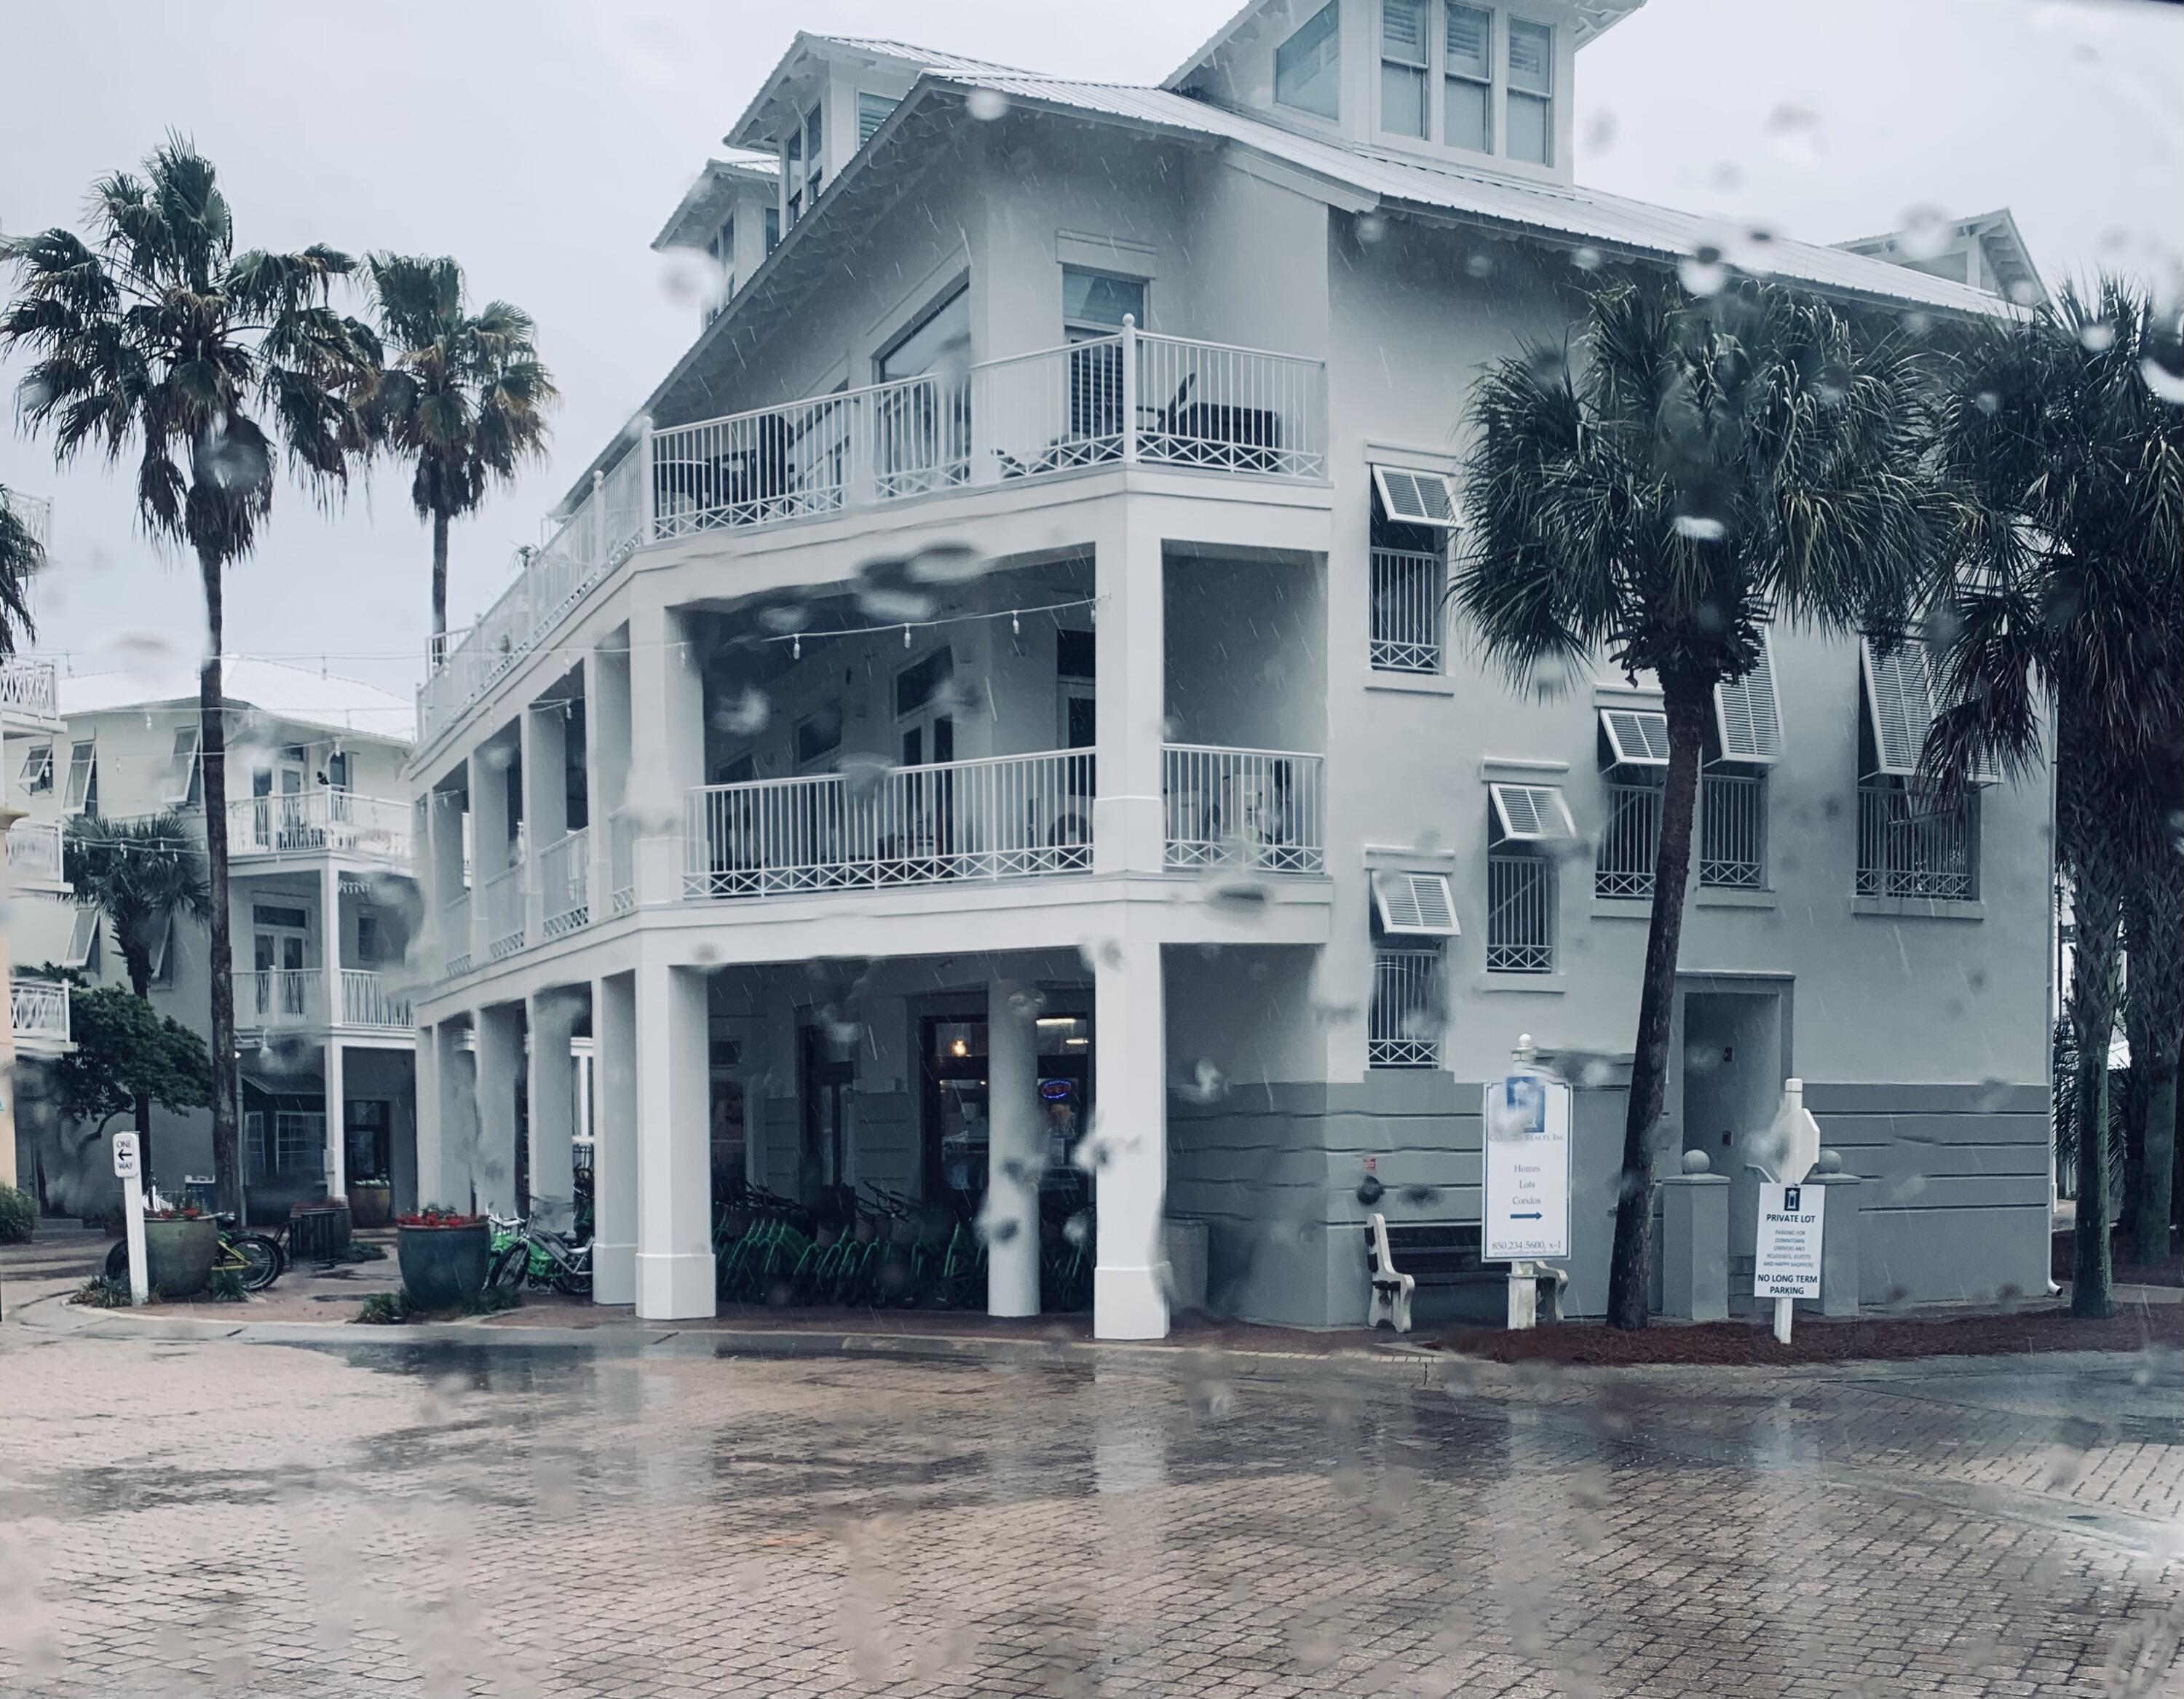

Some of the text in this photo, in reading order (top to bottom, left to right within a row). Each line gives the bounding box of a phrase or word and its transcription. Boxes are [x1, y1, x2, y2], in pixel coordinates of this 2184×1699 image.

[1041, 1085, 1071, 1095] OPEN
[1514, 1164, 1540, 1173] Homes
[1519, 1180, 1535, 1189] Lots
[1512, 1196, 1541, 1205] Condos
[1766, 1213, 1816, 1223] PRIVATE LOT
[1772, 1274, 1793, 1282] LONG
[1795, 1275, 1817, 1283] TERM
[1770, 1286, 1804, 1294] PARKING
